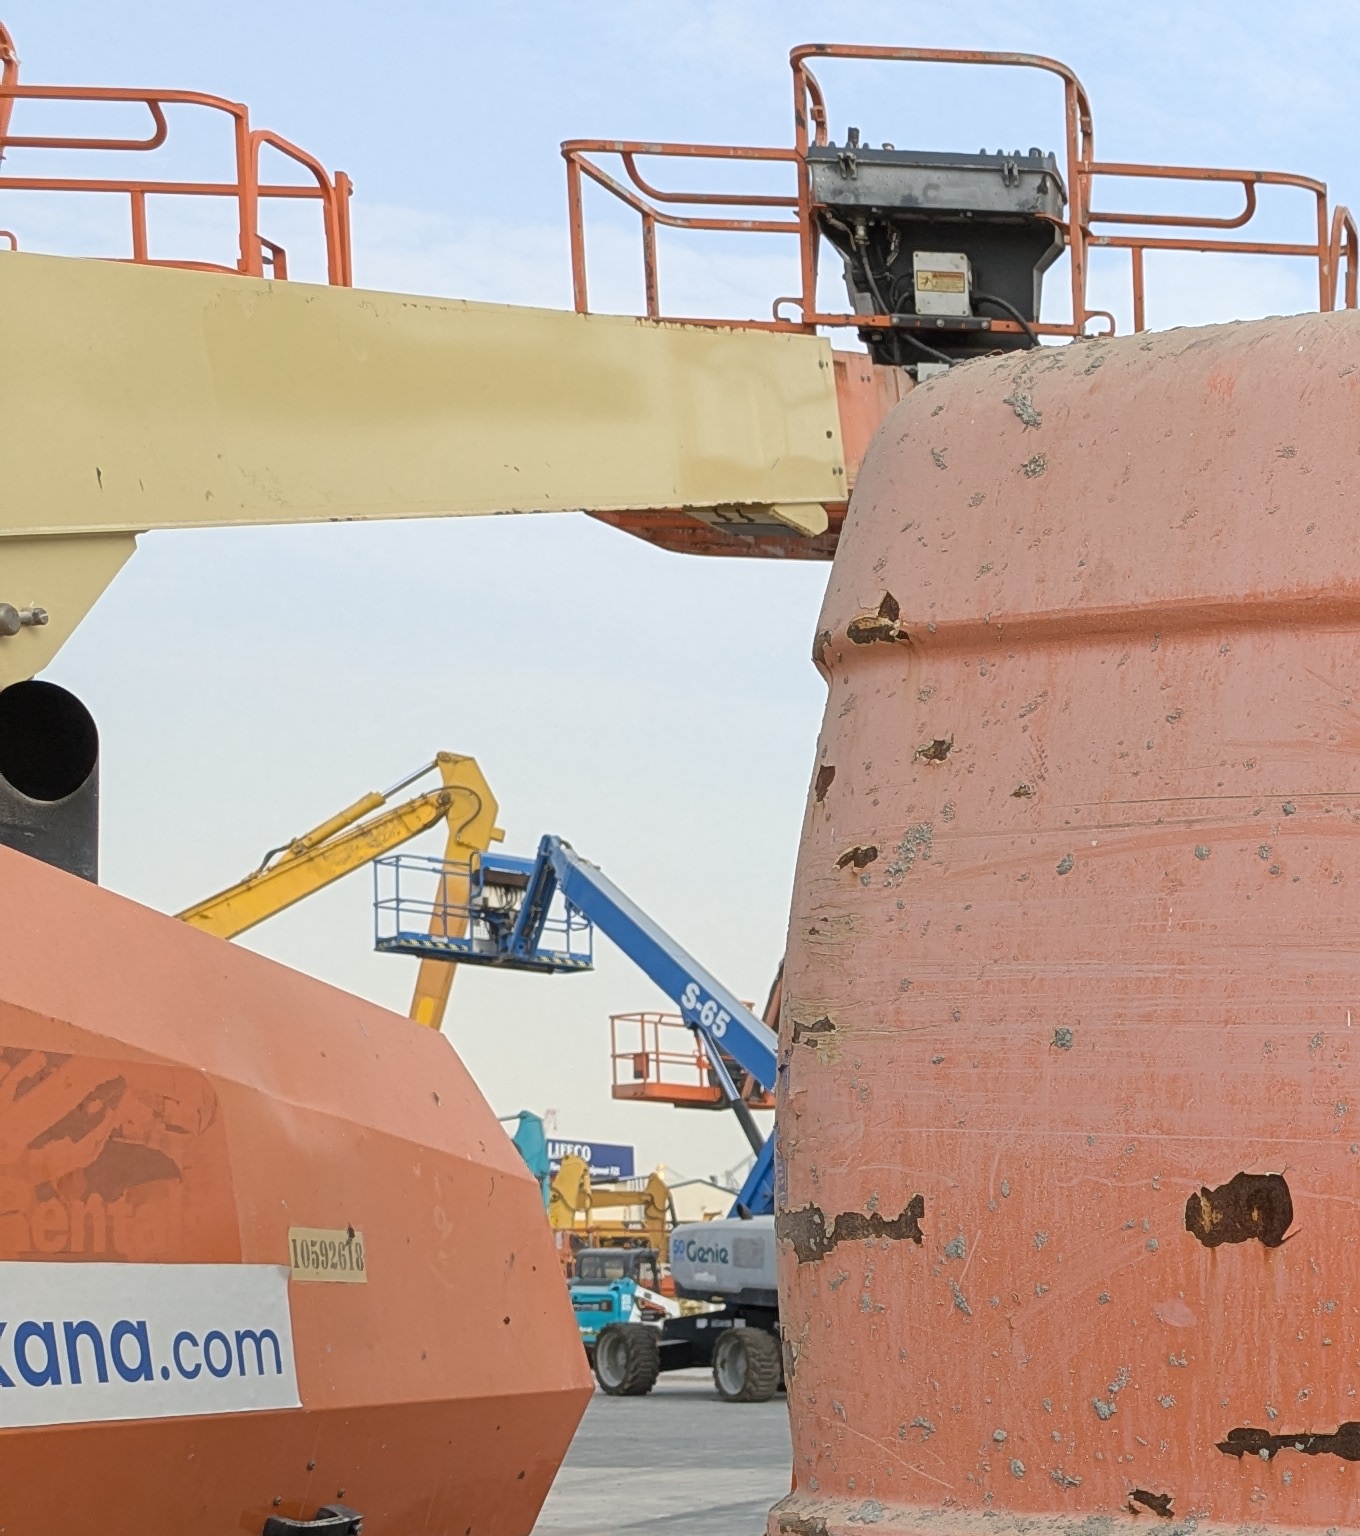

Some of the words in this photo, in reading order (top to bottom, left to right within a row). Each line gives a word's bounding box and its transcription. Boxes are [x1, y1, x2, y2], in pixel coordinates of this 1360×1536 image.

[681, 982, 732, 1038] S-65
[291, 1237, 365, 1272] 10592618
[686, 1240, 729, 1264] Genie
